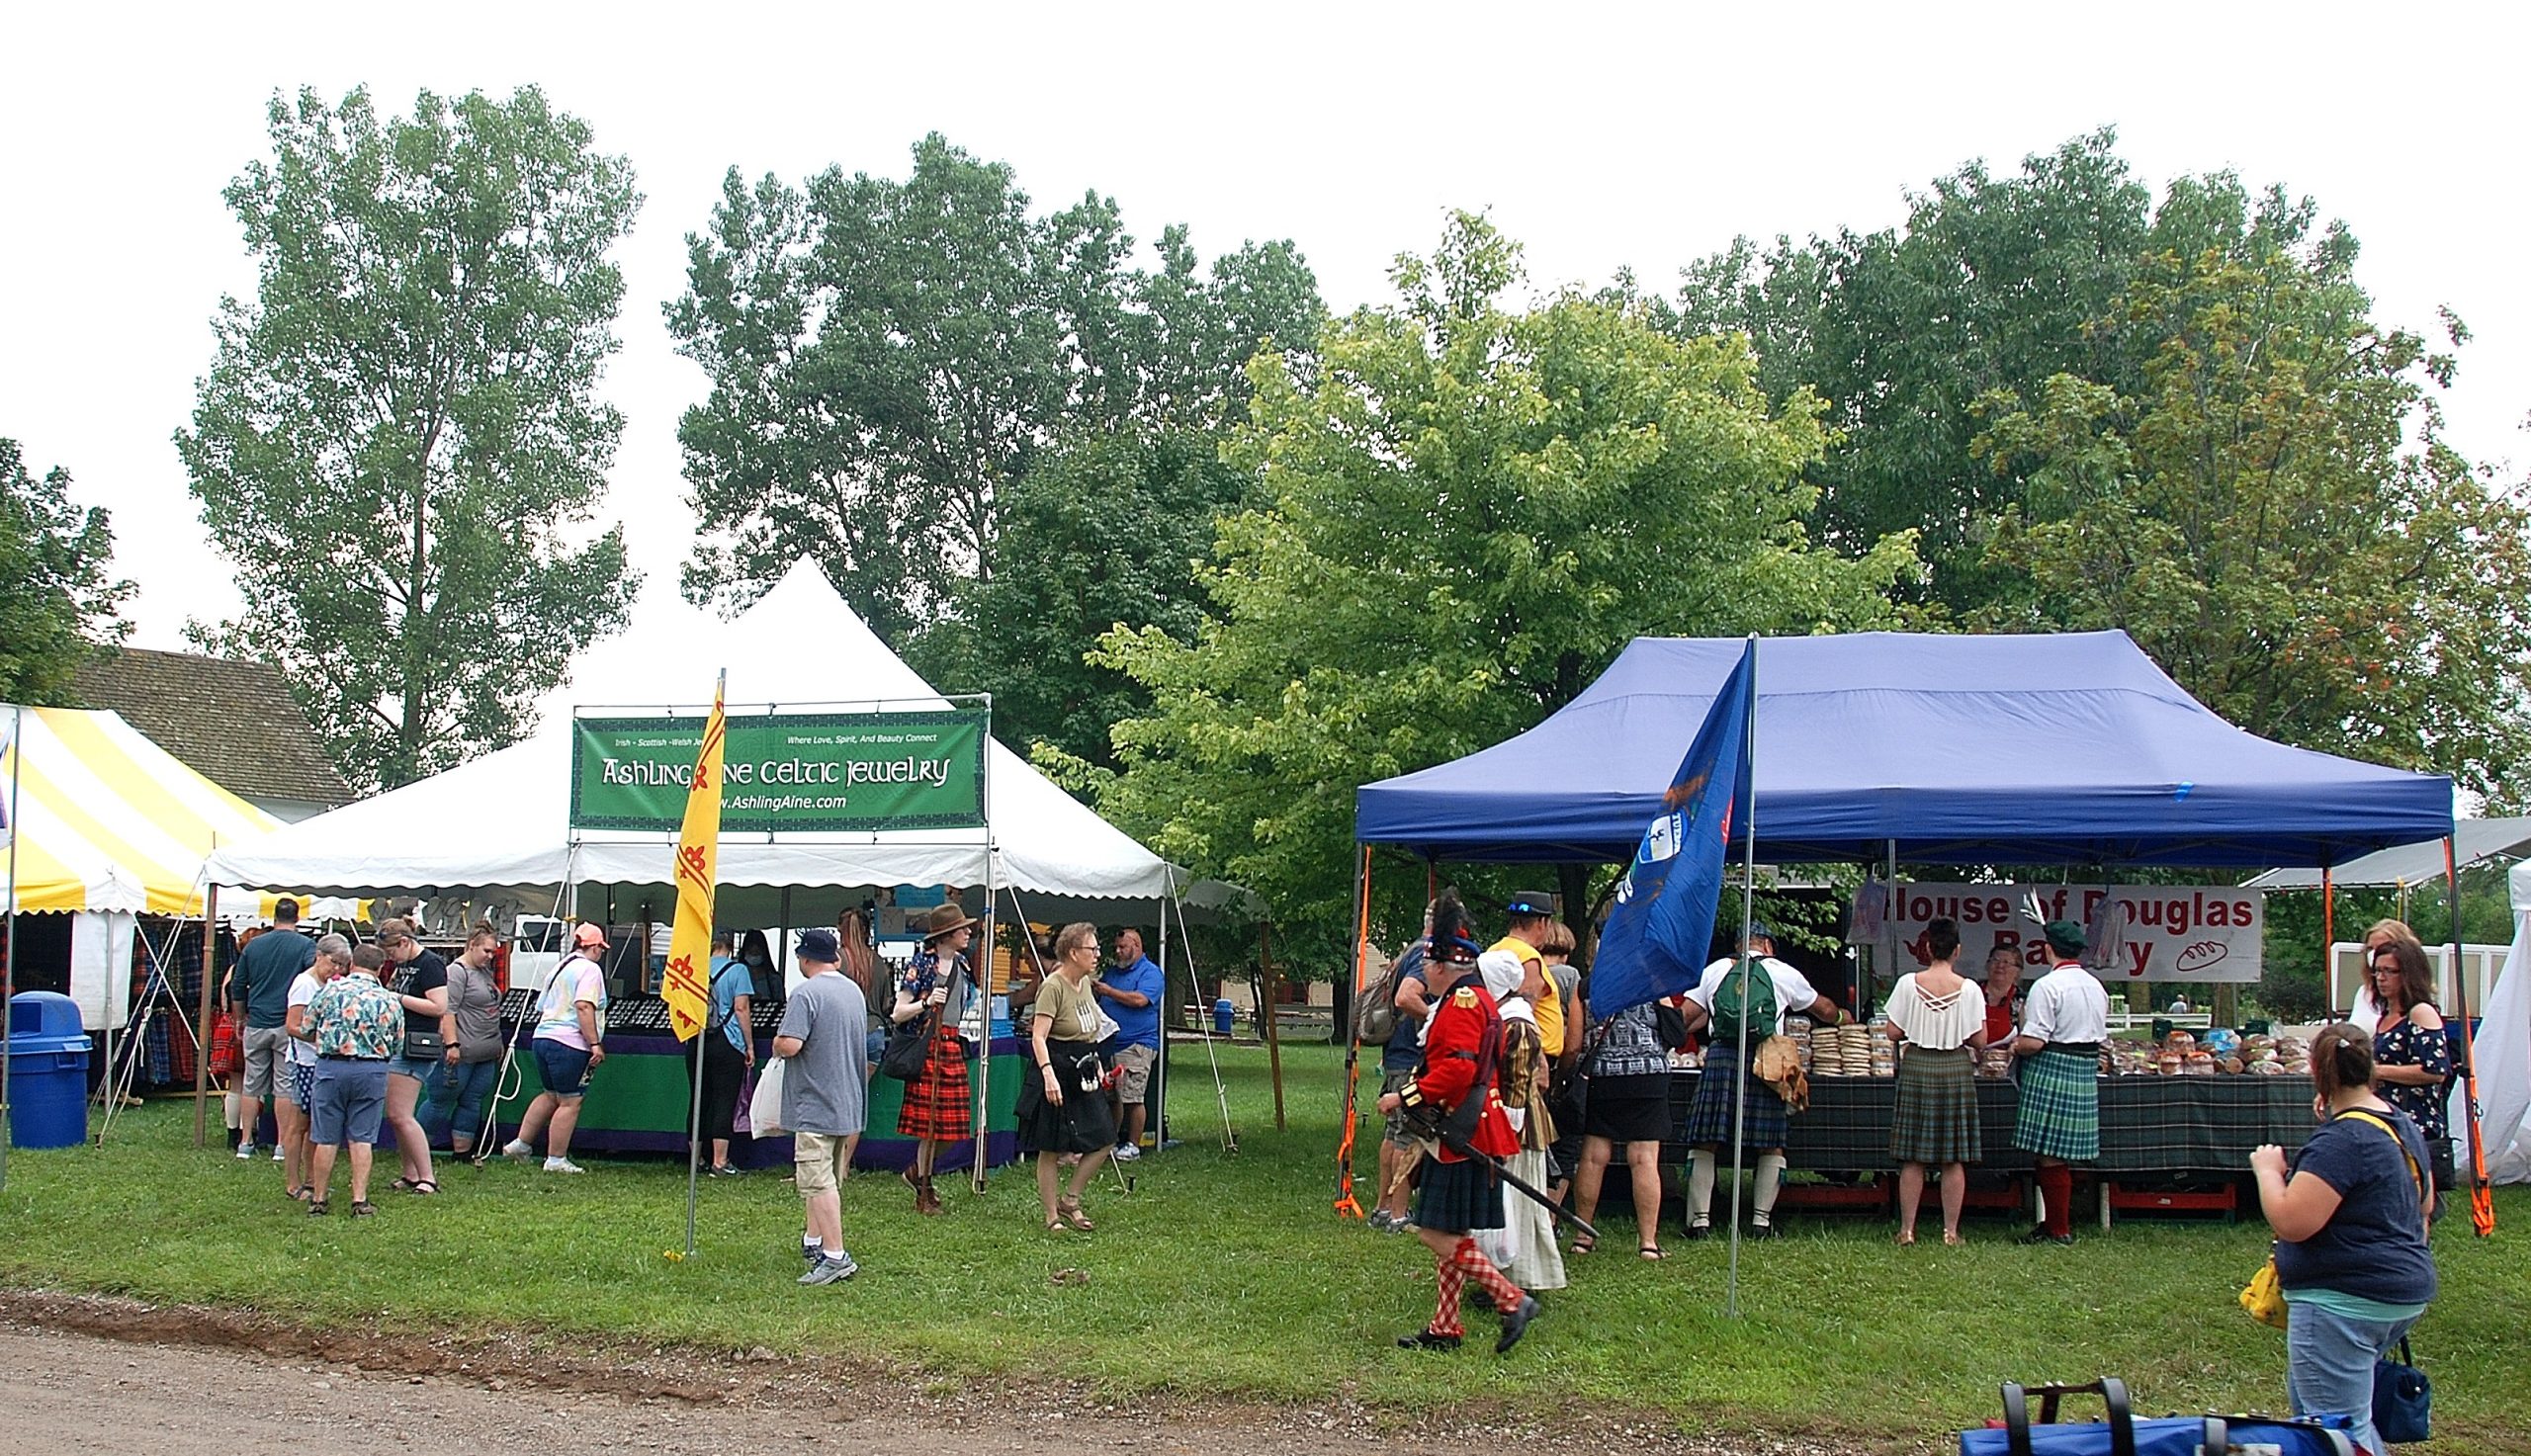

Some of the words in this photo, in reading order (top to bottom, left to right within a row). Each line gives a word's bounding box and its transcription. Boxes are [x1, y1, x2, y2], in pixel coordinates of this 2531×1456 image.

[638, 738, 667, 747] Scottish
[787, 735, 812, 744] Where
[814, 735, 833, 745] Love,
[835, 734, 857, 744] Spirit,
[860, 733, 876, 743] And
[877, 733, 904, 744] Beauty
[906, 733, 937, 743] Connect
[759, 757, 839, 784] Celtic
[845, 756, 951, 787] Jewelry
[1882, 887, 2010, 924] House
